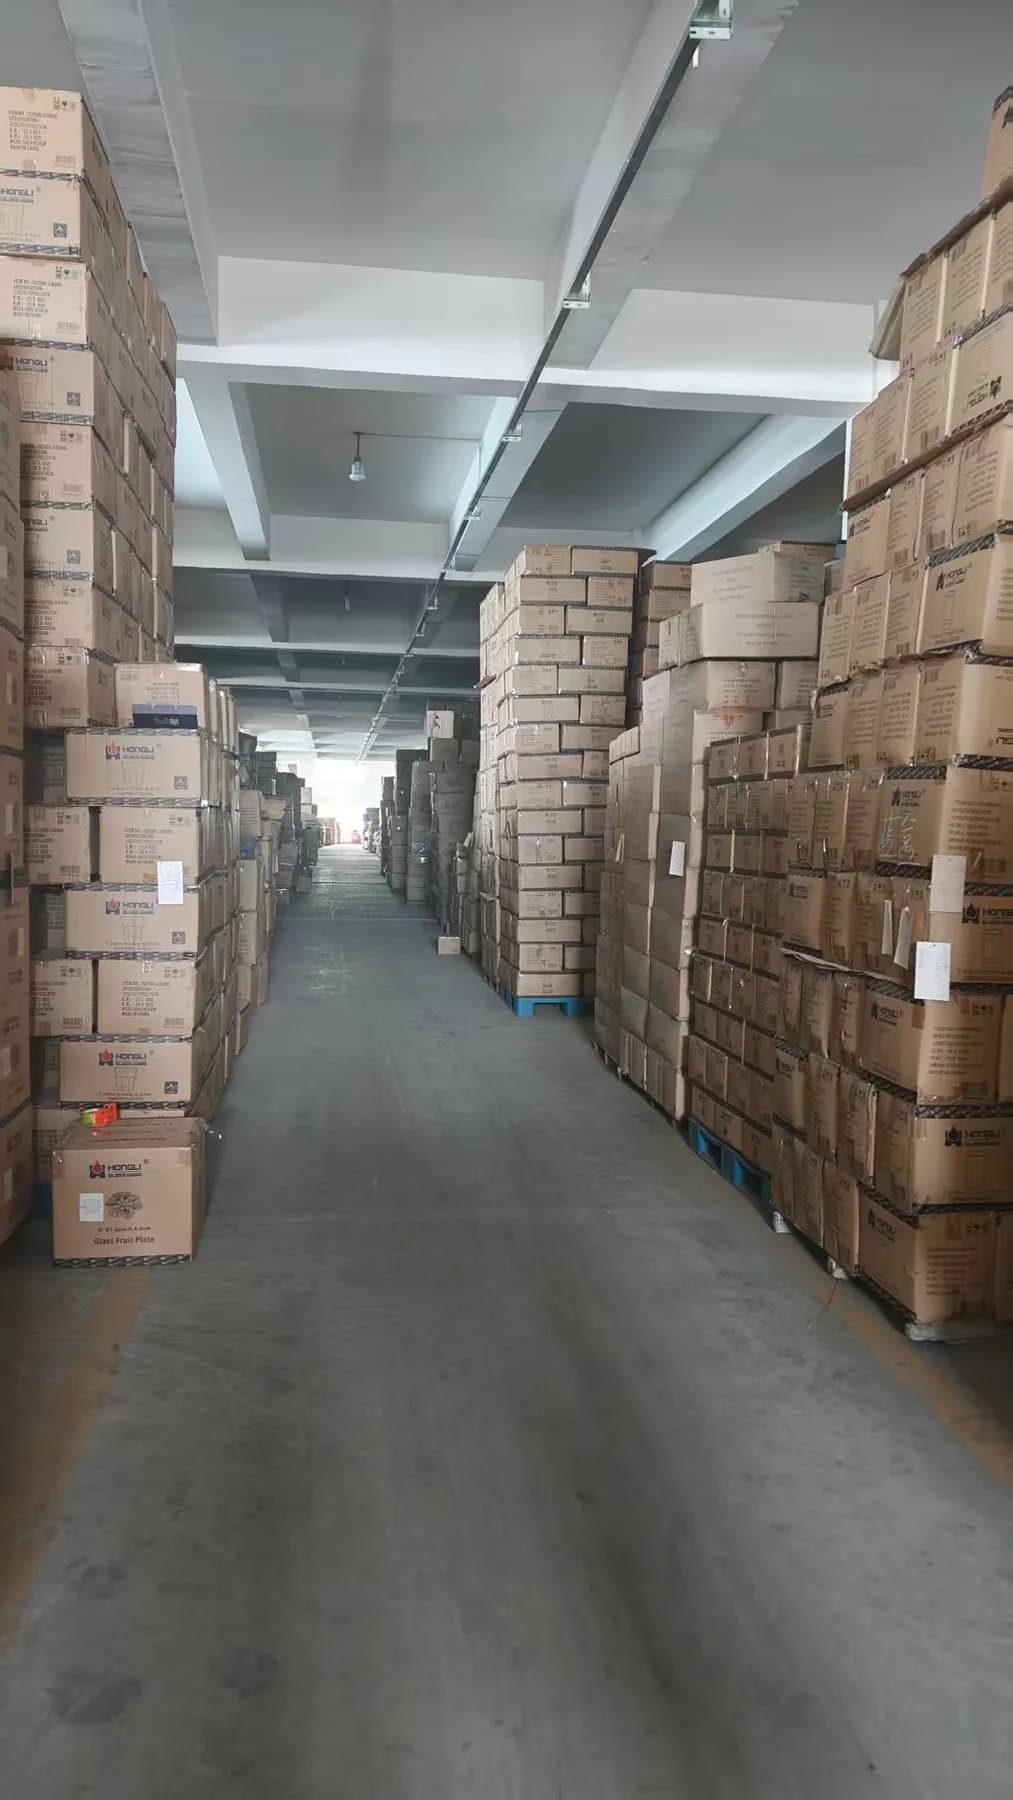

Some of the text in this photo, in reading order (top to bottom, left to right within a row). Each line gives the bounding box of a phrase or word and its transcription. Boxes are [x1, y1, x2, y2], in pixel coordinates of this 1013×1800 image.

[15, 357, 48, 367] HONGLI
[122, 745, 154, 753] HONGLI
[122, 901, 154, 909] HONGLI
[115, 1052, 147, 1060] HONGLI
[107, 1163, 142, 1171] HONGLI
[93, 1235, 155, 1245] Glass Fruit Plate
